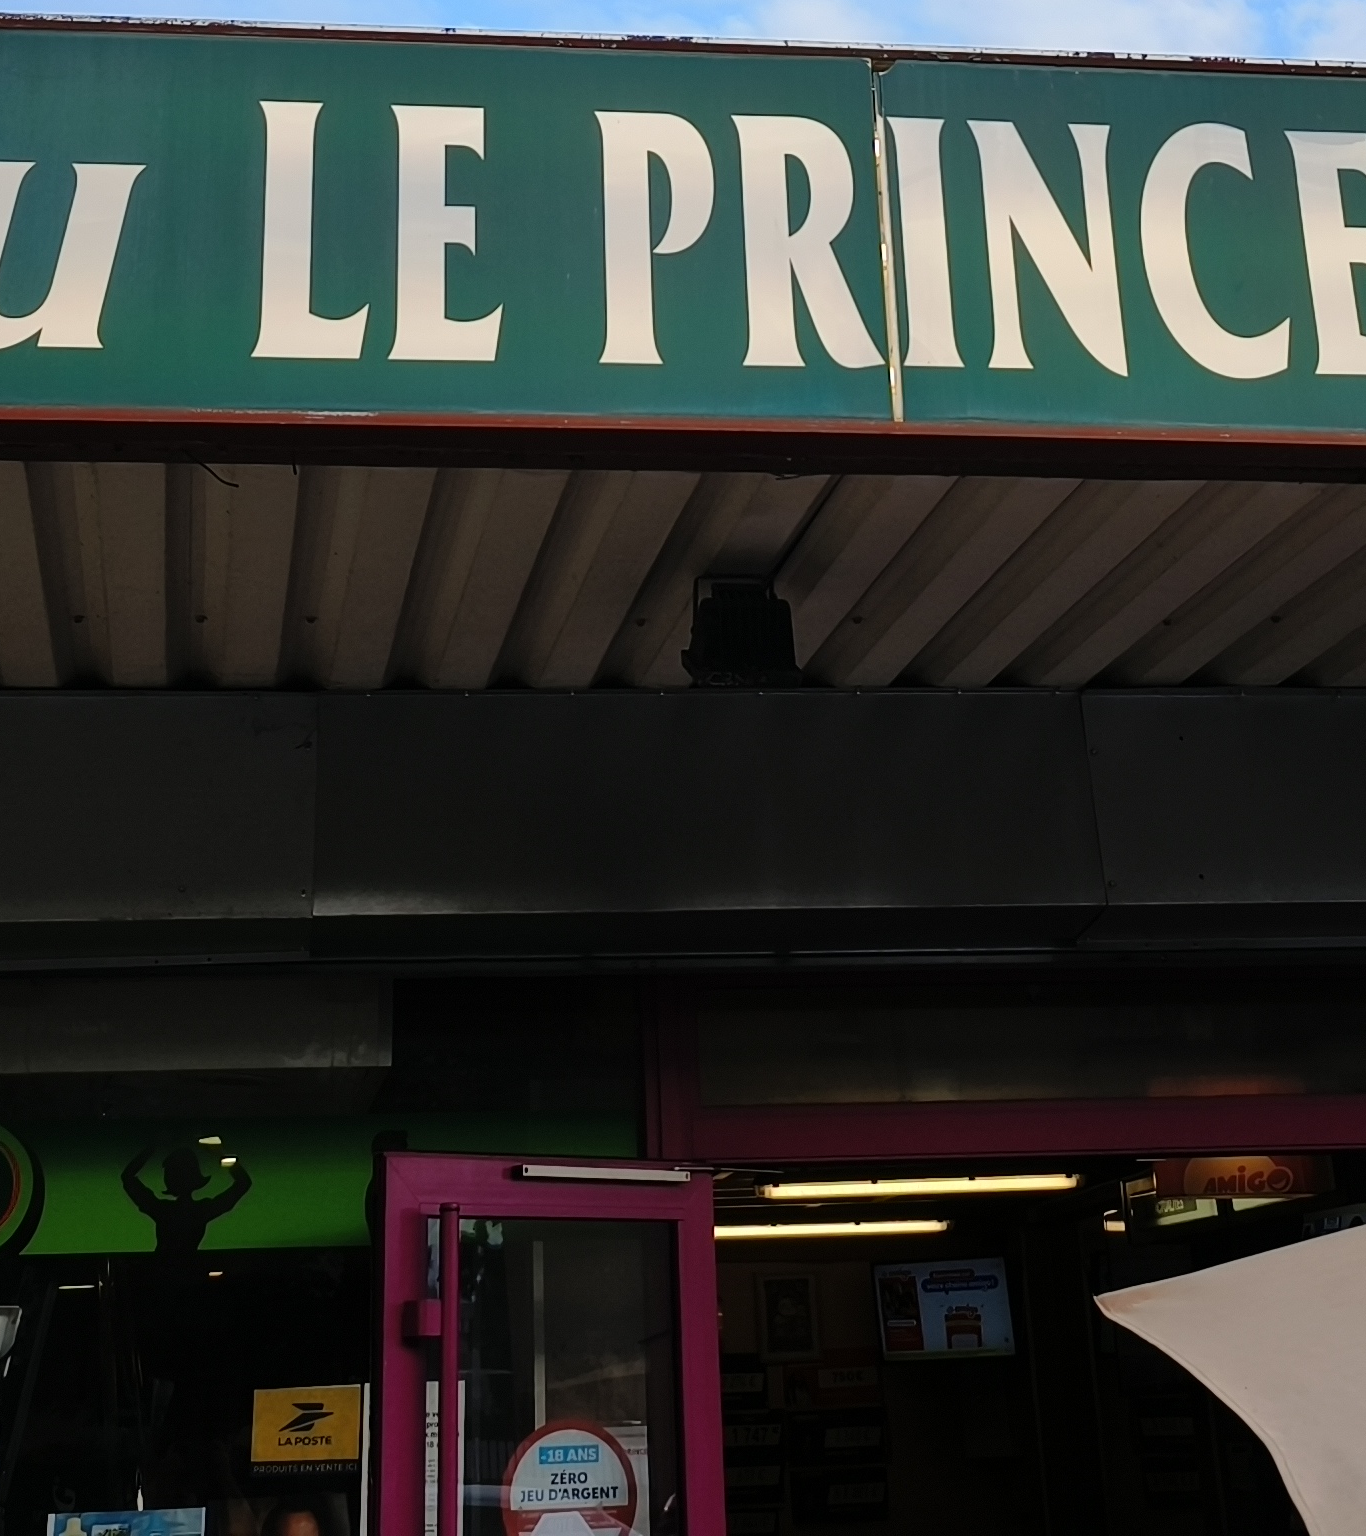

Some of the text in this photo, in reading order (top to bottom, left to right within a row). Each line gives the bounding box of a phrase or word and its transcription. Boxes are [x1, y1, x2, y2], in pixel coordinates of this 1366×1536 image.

[250, 99, 504, 362] LE
[278, 1435, 332, 1446] LA POSTE
[540, 1447, 597, 1463] -18 ANS
[253, 1463, 357, 1473] PRODUITS EN VENTE ICI
[550, 1469, 588, 1485] ZÉRO
[520, 1486, 619, 1503] JEU D'ARGENT
